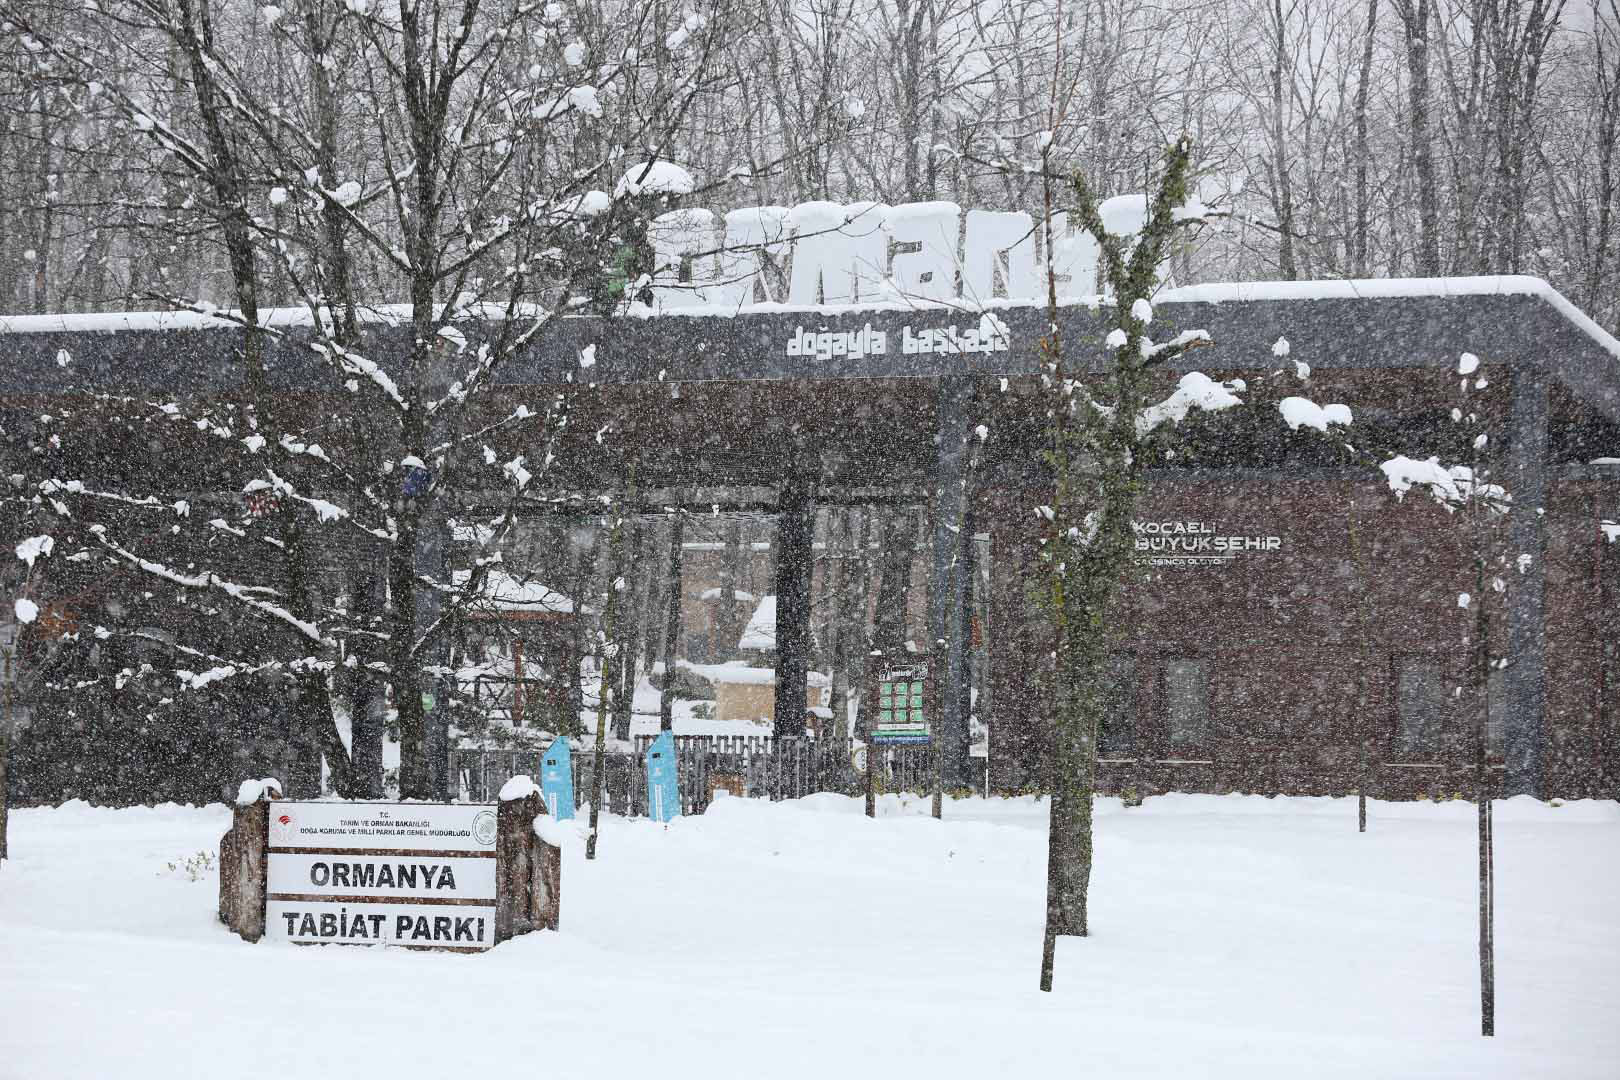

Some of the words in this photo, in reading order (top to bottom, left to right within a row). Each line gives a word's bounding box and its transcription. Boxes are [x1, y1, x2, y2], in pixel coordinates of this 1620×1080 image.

[787, 323, 886, 360] doğayla
[376, 828, 405, 837] PARKLAR
[406, 829, 428, 837] GENEL
[310, 862, 456, 889] ORMANYA
[282, 907, 386, 940] TABİAT
[396, 915, 485, 942] PARKI
